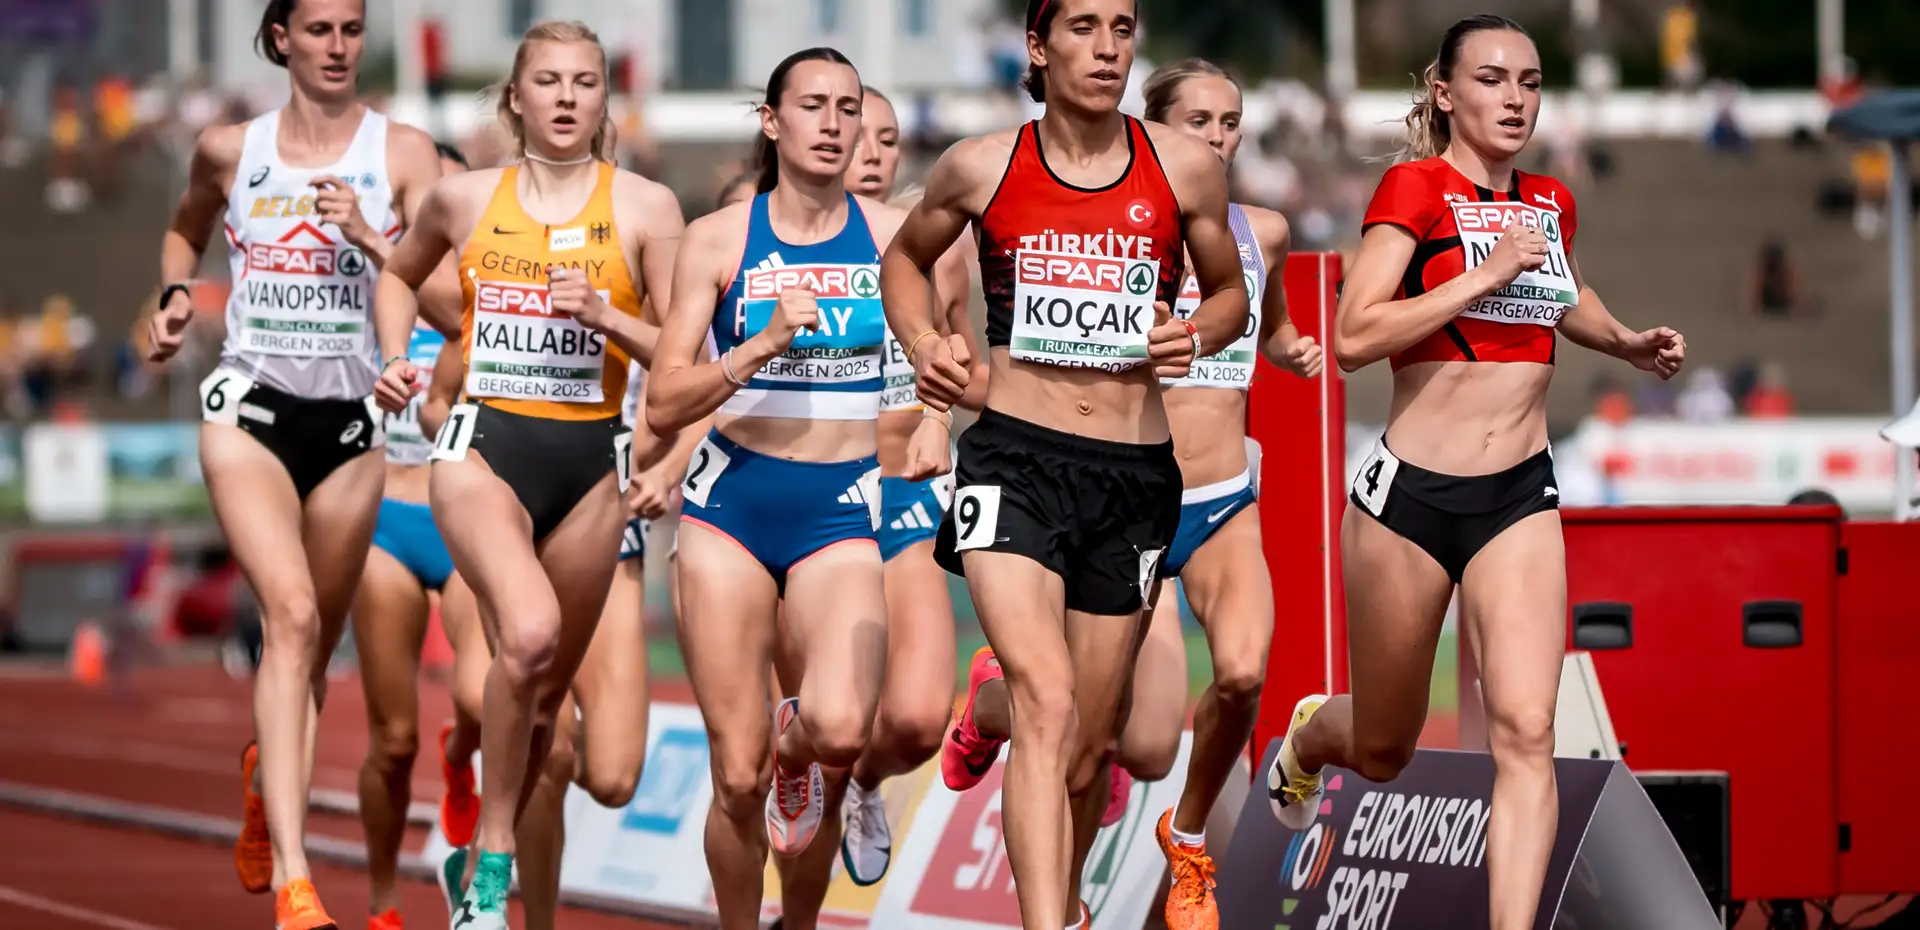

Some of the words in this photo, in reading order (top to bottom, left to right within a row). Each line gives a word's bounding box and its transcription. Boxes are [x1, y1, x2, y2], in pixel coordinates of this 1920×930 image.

[1458, 208, 1538, 229] SPAR
[1020, 228, 1152, 260] TÜRKİYE
[251, 246, 333, 272] SPAR
[1021, 257, 1122, 289] SPAR
[248, 280, 364, 311] VANOPSTAL
[751, 270, 847, 295] SPAR
[1025, 295, 1143, 337] KOÇAK
[1467, 301, 1535, 319] BERGEN
[1534, 304, 1564, 322] 202
[250, 333, 313, 351] BERGEN
[317, 338, 354, 351] 2025
[476, 321, 602, 356] KALLABIS
[1045, 341, 1075, 353] RUN
[501, 364, 528, 376] RUN
[757, 361, 829, 377] BERGEN
[834, 360, 870, 377] 2025
[1213, 366, 1247, 381] 2025
[206, 377, 231, 412] 6
[478, 377, 547, 396] BERGEN
[552, 383, 591, 397] 2025
[686, 447, 709, 492] 2
[1364, 459, 1385, 498] 4
[959, 495, 981, 541] 9
[1315, 866, 1409, 930] SPORT
